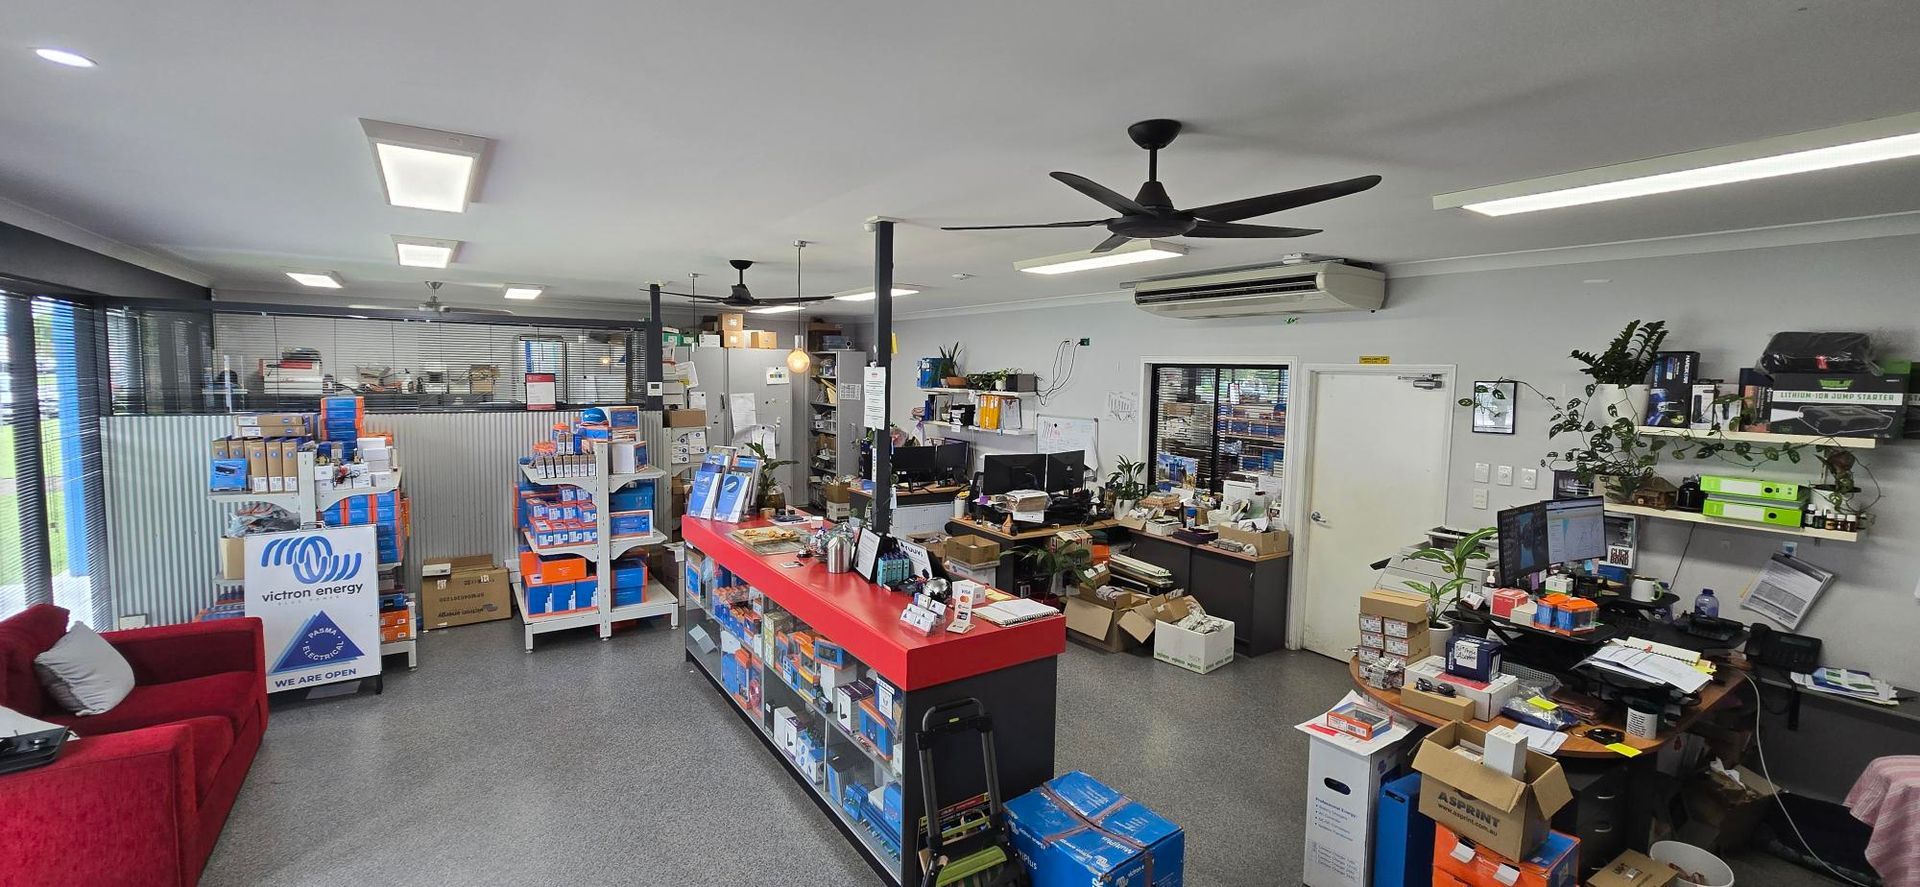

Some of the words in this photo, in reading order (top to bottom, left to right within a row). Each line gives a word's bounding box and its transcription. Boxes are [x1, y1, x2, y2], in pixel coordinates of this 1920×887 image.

[1780, 391, 1829, 399] LITHIUM-ION
[1857, 393, 1895, 401] STARTER
[262, 589, 311, 602] victron
[315, 583, 364, 596] energy
[308, 627, 337, 639] PASMA
[302, 641, 344, 661] ELECTRICAL
[275, 678, 295, 688] WE
[298, 673, 323, 685] ARE
[325, 668, 357, 680] OPEN
[1437, 803, 1498, 836] www.asprint.com.au
[1438, 791, 1500, 828] ASPRINT
